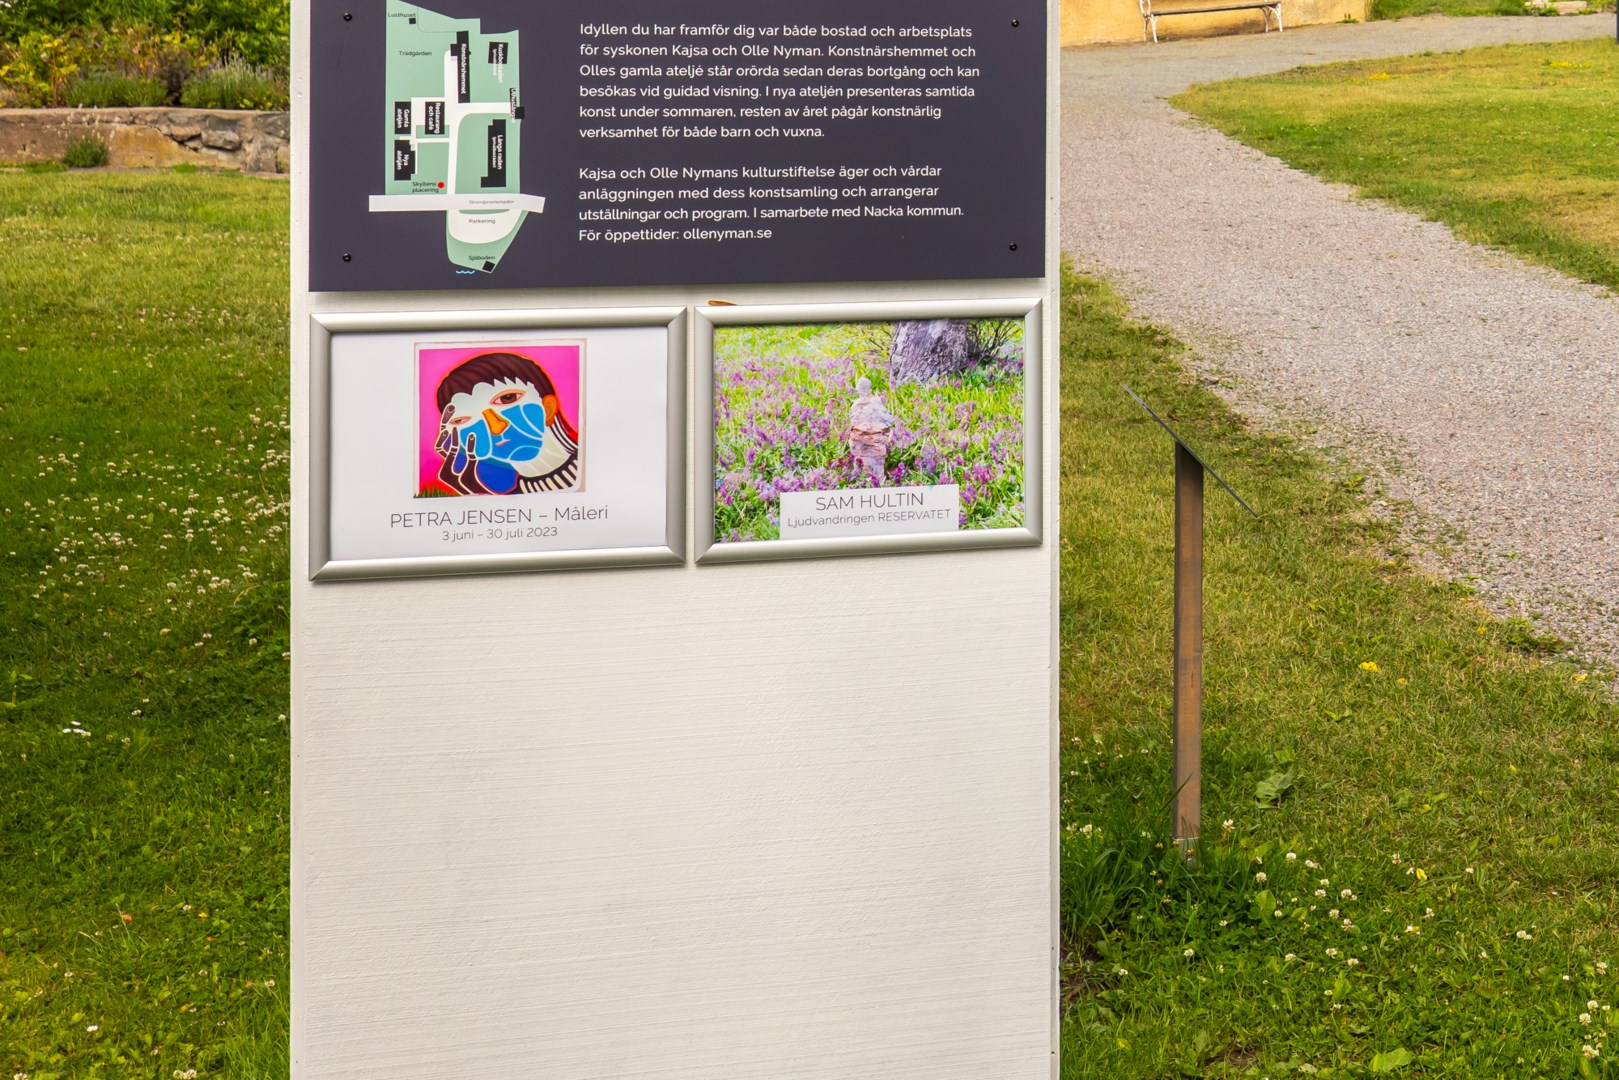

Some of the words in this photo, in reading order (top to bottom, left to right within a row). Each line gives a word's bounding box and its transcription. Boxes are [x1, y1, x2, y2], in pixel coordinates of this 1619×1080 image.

[580, 23, 628, 38] Idyllen
[631, 23, 650, 36] du
[653, 23, 677, 36] har
[679, 23, 730, 36] framför
[733, 24, 755, 39] dig
[758, 27, 780, 36] var
[783, 24, 818, 37] både
[821, 24, 867, 37] bostad
[870, 25, 895, 37] och
[898, 25, 973, 40] arbetsplats
[579, 43, 600, 56] för
[602, 44, 668, 59] syskonen
[672, 44, 709, 58] Kajsa
[711, 44, 738, 56] och
[741, 44, 770, 57] Olle
[773, 45, 824, 59] Nyman.
[828, 45, 949, 57] Konstnärshemmet
[951, 45, 976, 57] och
[579, 64, 616, 77] Olles
[619, 64, 663, 79] gamla
[665, 64, 704, 79] ateljé
[707, 64, 733, 77] står
[735, 65, 780, 77] orörda
[783, 65, 823, 77] sedan
[826, 65, 864, 77] deras
[867, 65, 926, 80] bortgång
[929, 65, 954, 77] och
[957, 65, 980, 77] kan
[579, 85, 637, 97] besökas
[639, 85, 660, 97] vid
[663, 85, 710, 100] guidad
[712, 85, 762, 100] visning.
[765, 85, 769, 97] I
[772, 87, 796, 100] nya
[799, 85, 844, 99] ateljén
[846, 85, 922, 99] presenteras
[925, 85, 975, 97] samtida
[434, 102, 442, 135] Restaurang
[579, 105, 617, 118] konst
[619, 105, 660, 118] under
[662, 108, 737, 118] sommaren,
[740, 106, 781, 117] resten
[784, 107, 800, 117] av
[802, 105, 829, 117] året
[831, 105, 869, 120] pågår
[871, 105, 942, 120] konstnärlig
[579, 126, 659, 138] verksamhet
[661, 125, 681, 138] för
[683, 125, 718, 138] både
[720, 125, 751, 138] barn
[754, 125, 780, 138] och
[782, 128, 825, 137] vuxna.
[496, 135, 504, 152] Långa
[579, 167, 616, 182] Kajsa
[619, 167, 646, 179] och
[649, 167, 679, 179] Olle
[682, 167, 739, 182] Nymans
[742, 165, 836, 178] kulturstiftelse
[838, 165, 870, 180] äger
[872, 165, 897, 177] och
[900, 165, 942, 177] vårdar
[578, 187, 674, 203] anläggningen
[678, 187, 709, 199] med
[712, 186, 746, 199] dess
[749, 186, 838, 200] konstsamling
[841, 185, 867, 198] och
[870, 187, 940, 200] arrangerar
[578, 208, 662, 223] utställningar
[663, 207, 689, 220] och
[691, 209, 750, 222] program.
[753, 207, 757, 218] I
[760, 206, 829, 219] samarbete
[831, 205, 861, 217] med
[864, 205, 904, 217] Nacka
[906, 205, 964, 217] kommun.
[579, 229, 602, 241] För
[604, 228, 680, 244] öppettider:
[682, 227, 773, 242] ollenyman.se
[815, 496, 854, 511] SAM
[860, 492, 924, 509] HULTIN
[390, 511, 453, 528] PETRA
[457, 508, 532, 526] JENSEN
[554, 505, 608, 521] Måleri
[787, 514, 875, 529] Ljudvandringen
[878, 509, 951, 522] RESERVATET
[442, 530, 450, 541] 3
[451, 531, 474, 543] juni
[486, 528, 503, 539] 30
[504, 527, 523, 541] juli
[526, 526, 558, 538] 2023
